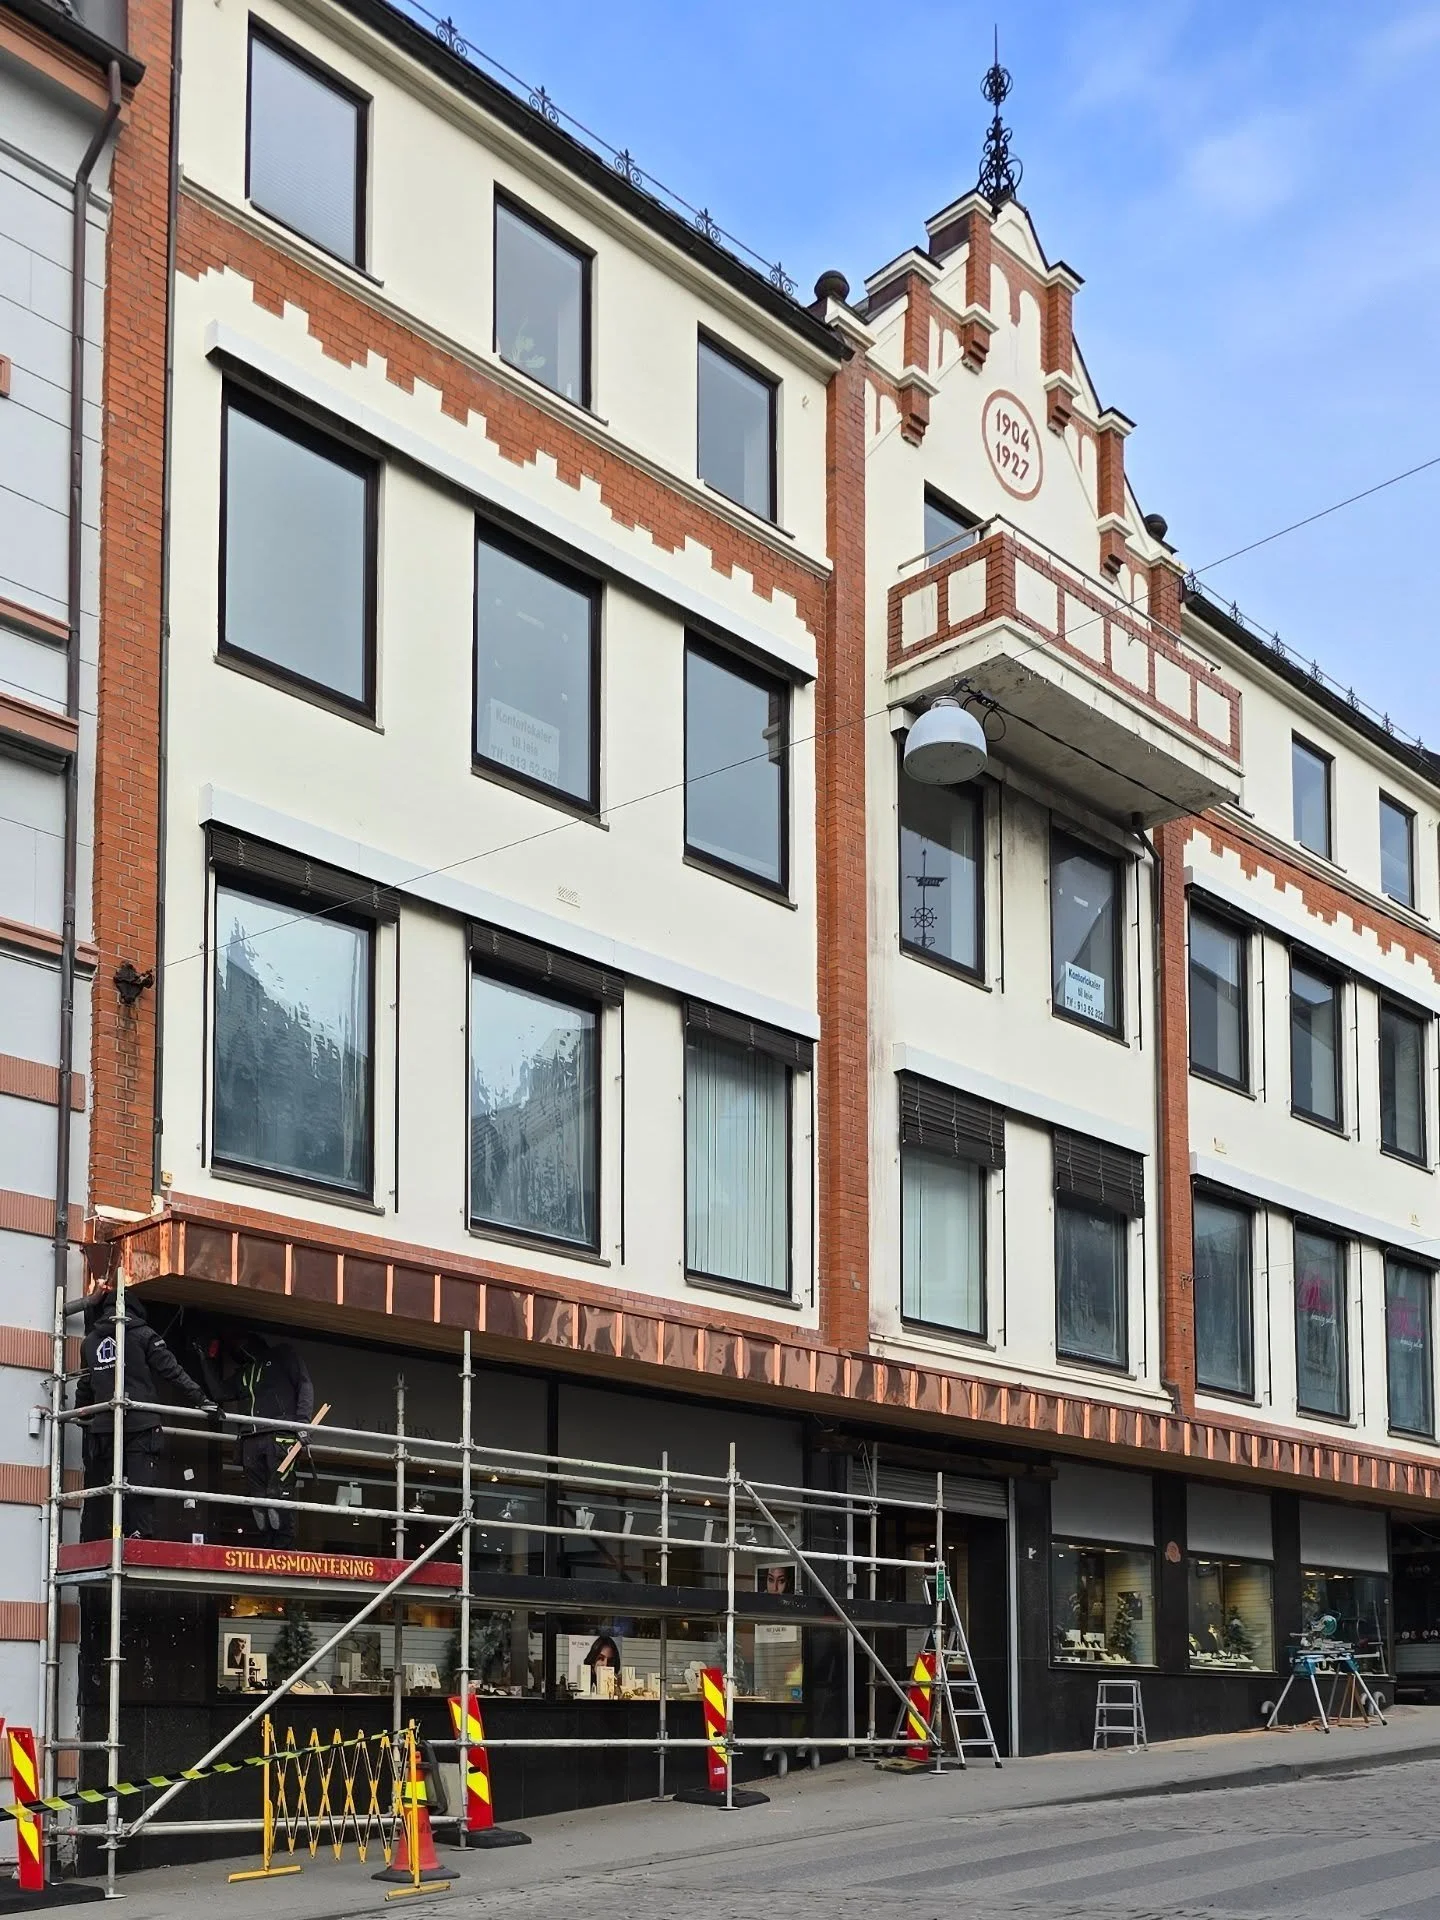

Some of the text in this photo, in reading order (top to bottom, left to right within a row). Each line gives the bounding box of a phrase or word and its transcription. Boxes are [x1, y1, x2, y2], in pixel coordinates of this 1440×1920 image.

[996, 408, 1029, 452] 1904
[995, 441, 1029, 480] 1927
[225, 1551, 374, 1577] STILLASMONTERING
